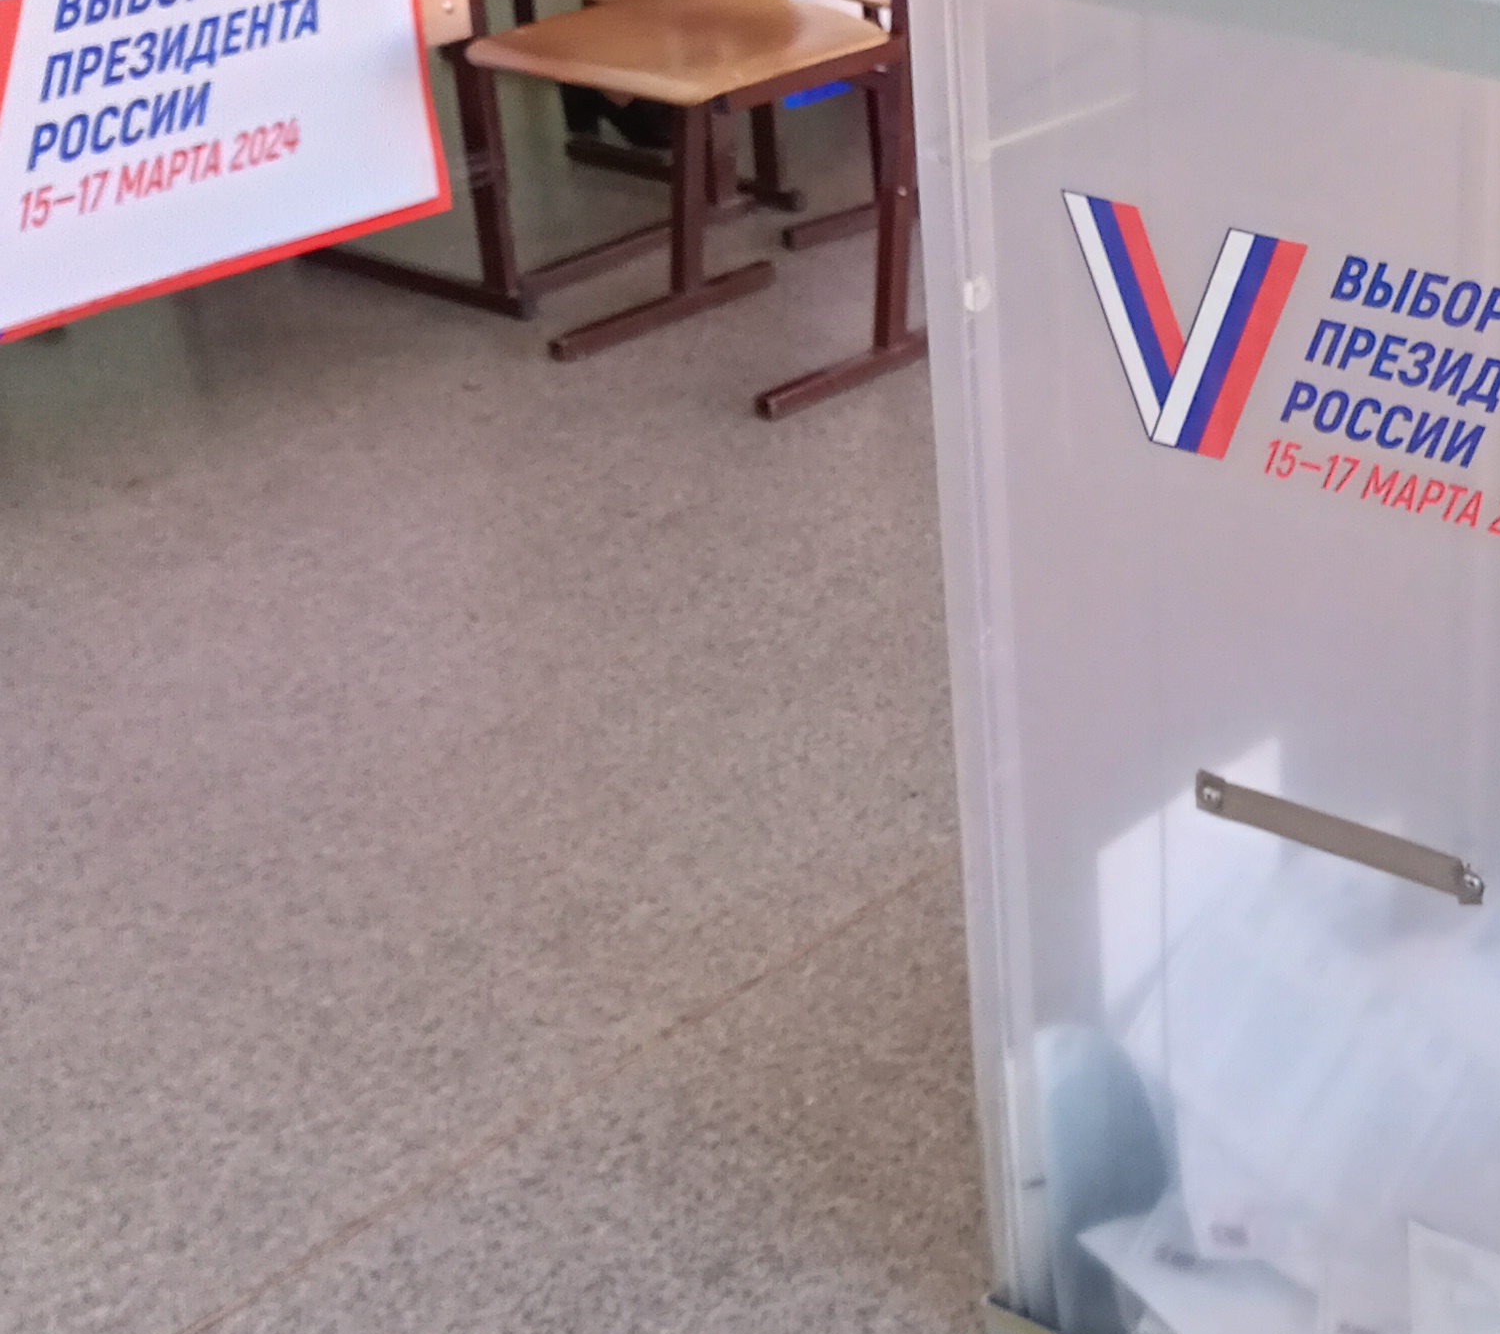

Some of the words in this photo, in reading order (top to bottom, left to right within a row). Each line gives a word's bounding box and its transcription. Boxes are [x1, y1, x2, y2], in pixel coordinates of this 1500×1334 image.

[27, 81, 212, 172] РОССИИ
[115, 138, 223, 204] МАРТА
[228, 118, 300, 173] 2024
[1279, 380, 1486, 469] РОССИИ
[1361, 463, 1483, 529] МАРТА
